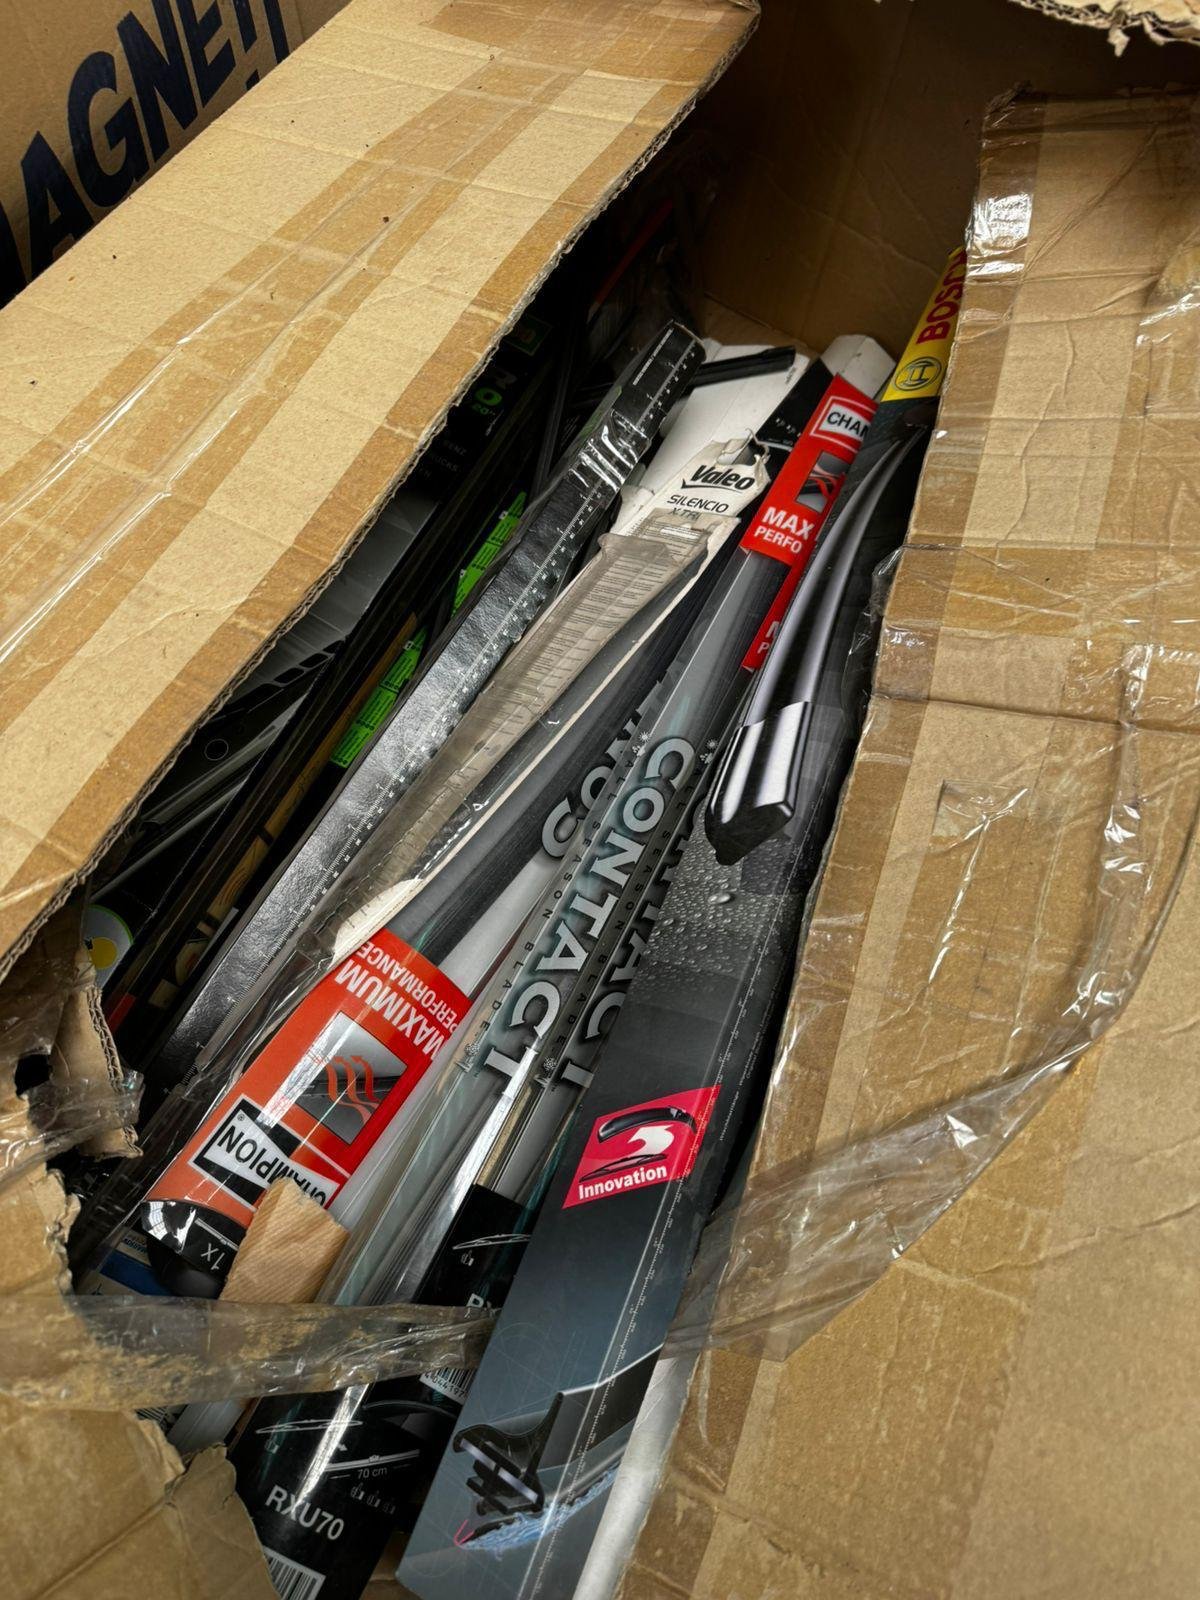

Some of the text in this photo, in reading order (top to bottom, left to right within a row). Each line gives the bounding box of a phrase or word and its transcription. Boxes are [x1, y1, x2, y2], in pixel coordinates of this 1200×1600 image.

[690, 465, 755, 490] Valeo
[667, 494, 730, 513] SILENCIO
[484, 738, 695, 1099] CONTACT
[578, 1165, 668, 1200] Innovation
[358, 1466, 388, 1479] 70 cm
[265, 1484, 345, 1540] RXU70
